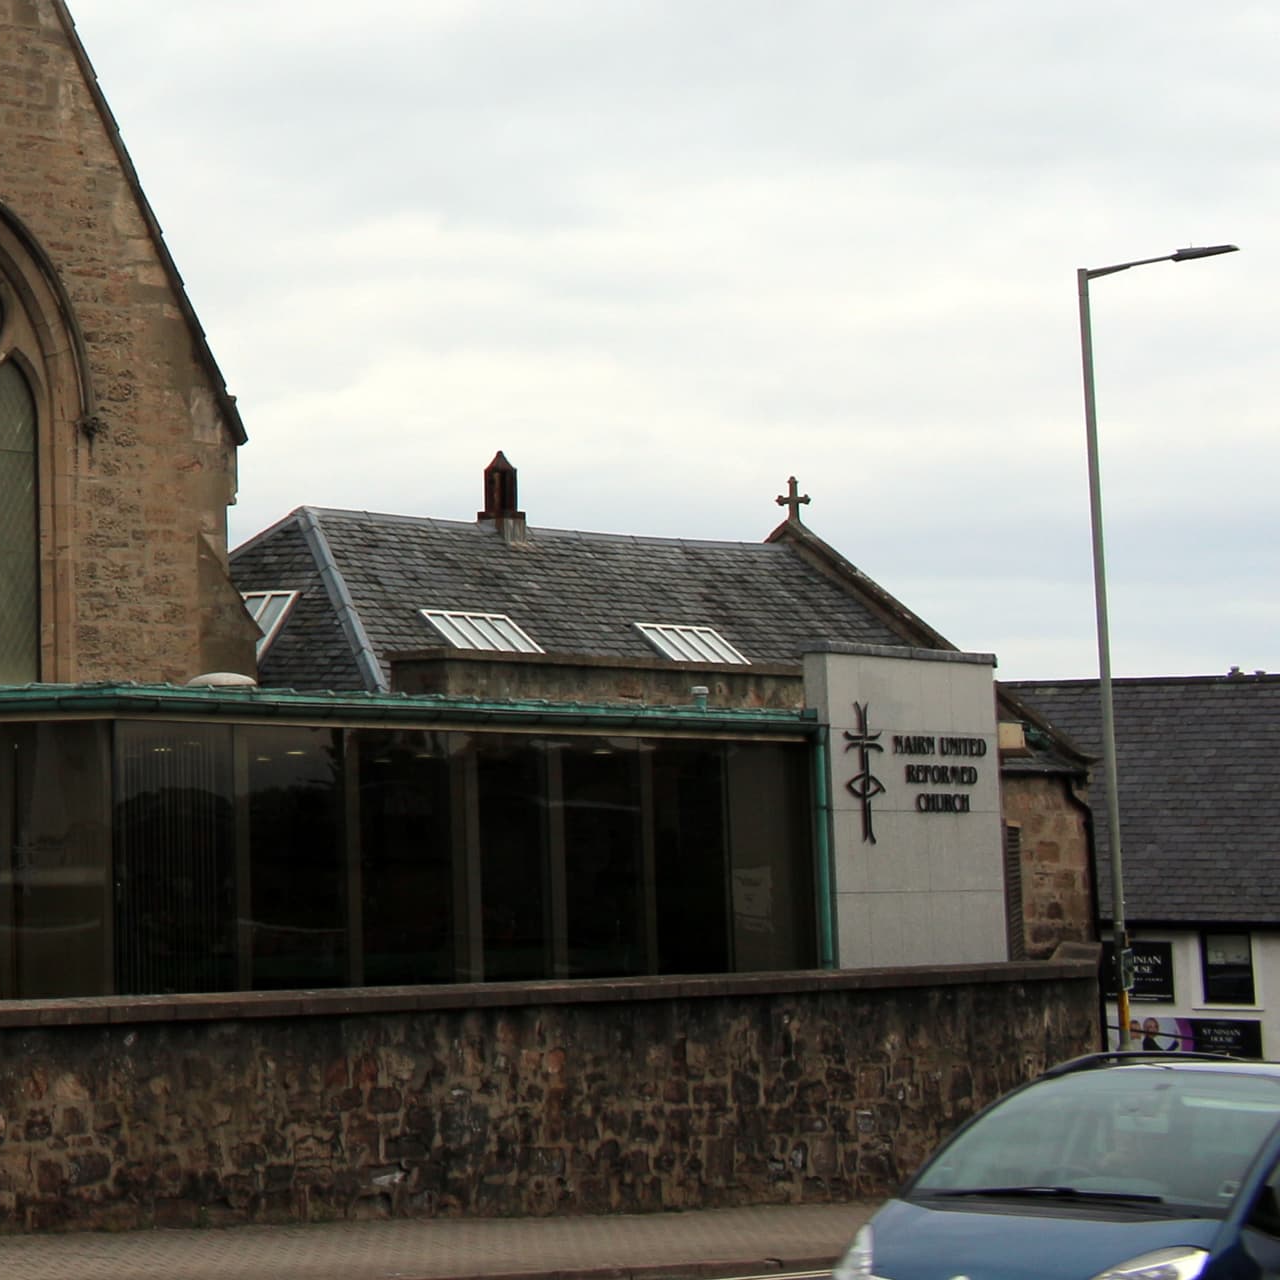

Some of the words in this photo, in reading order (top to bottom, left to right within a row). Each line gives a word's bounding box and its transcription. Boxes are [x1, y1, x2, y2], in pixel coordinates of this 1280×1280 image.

[893, 735, 935, 755] NAIRN
[940, 736, 987, 757] UNITED
[905, 764, 978, 785] REFORMED
[916, 793, 970, 813] CHURCH
